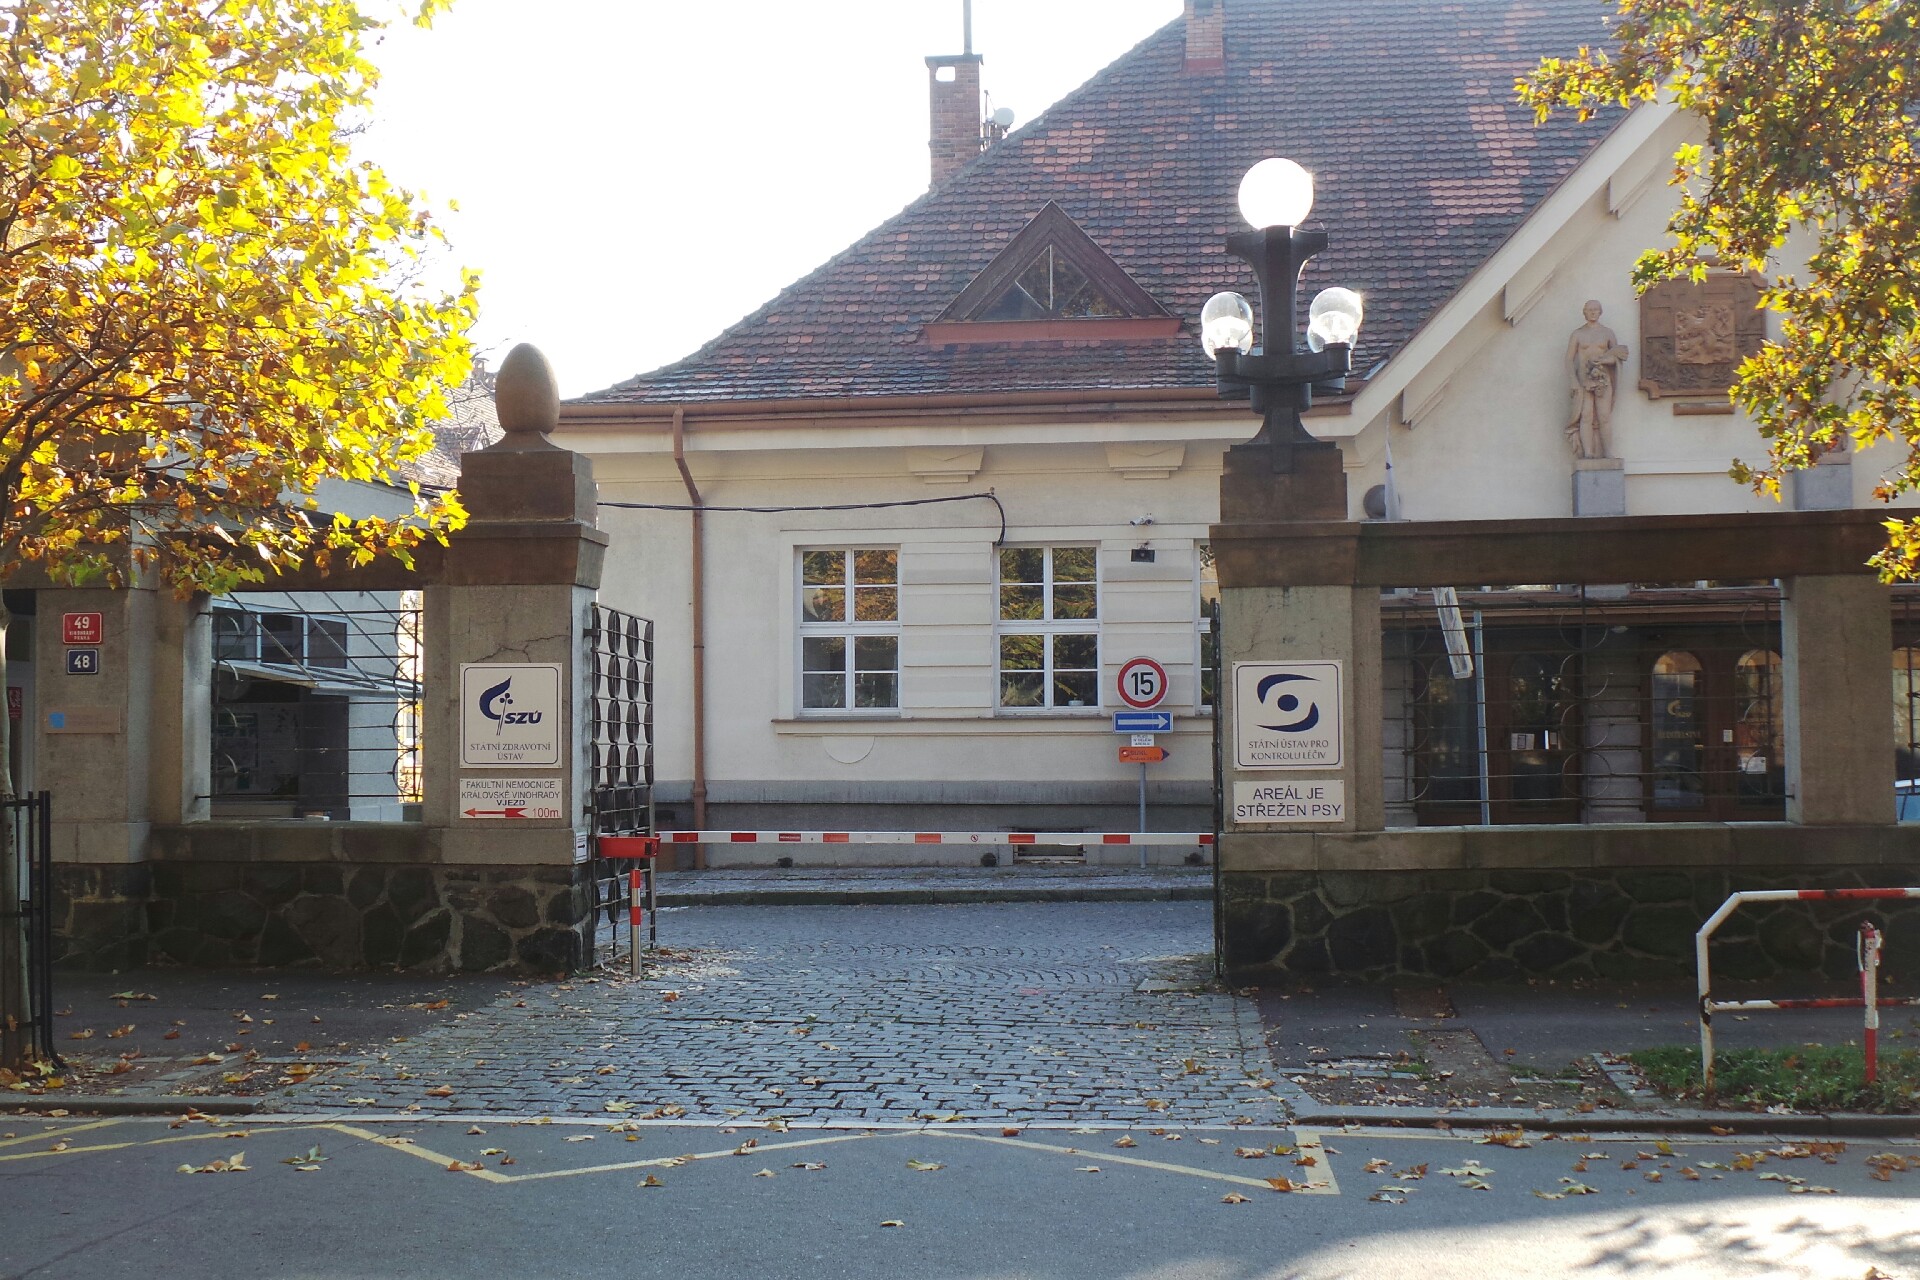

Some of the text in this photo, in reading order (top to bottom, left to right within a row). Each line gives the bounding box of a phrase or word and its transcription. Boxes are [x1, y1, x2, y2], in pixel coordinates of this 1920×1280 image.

[74, 616, 90, 629] 49
[74, 655, 90, 668] 48
[1131, 672, 1154, 696] 15
[504, 710, 542, 724] SZÚ
[470, 742, 551, 751] STÁTNÍ ZDRAVOTNÍ
[1248, 739, 1329, 749] STÁTNÍ ÚSTAV PRO
[497, 752, 524, 760] ÚSTAV
[1251, 750, 1327, 760] KONTROLU LÉČIV
[466, 780, 555, 789] FAKULTNÍ NEMOCNICE
[461, 790, 560, 799] KRÁLOVSKÉ VINOHRADY
[1253, 785, 1324, 800] AREÁL JE
[532, 807, 559, 818] 100m
[1237, 803, 1342, 817] STŘEŽEN PSY
